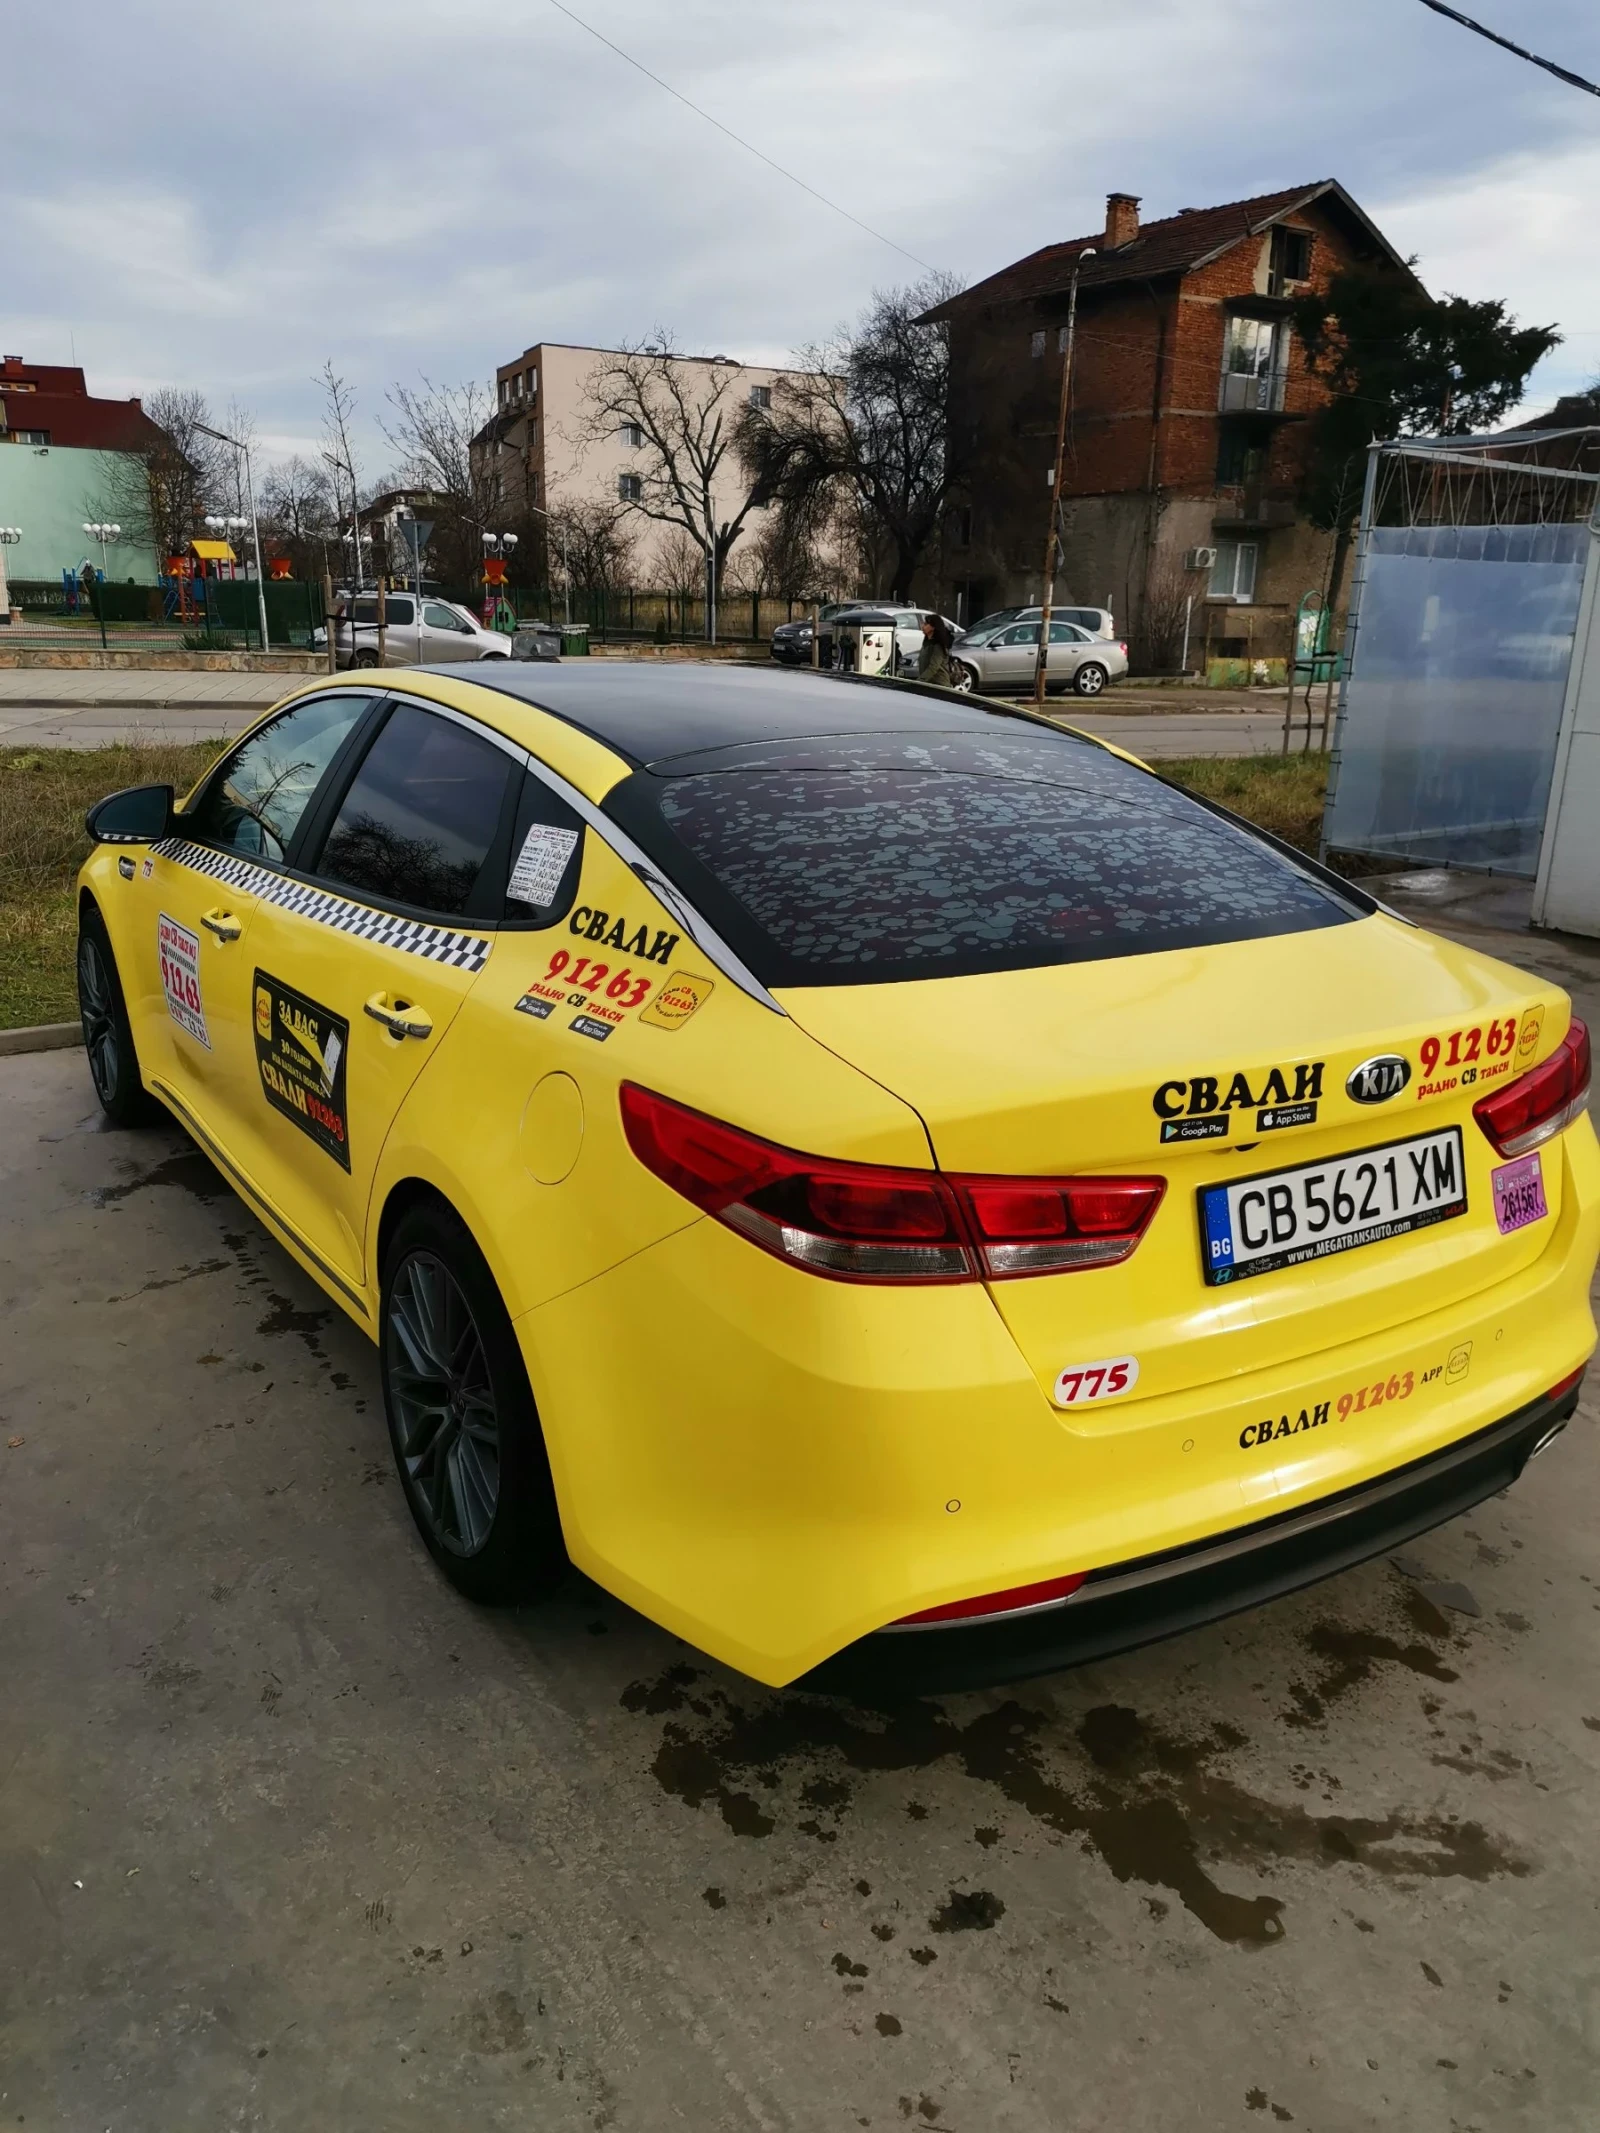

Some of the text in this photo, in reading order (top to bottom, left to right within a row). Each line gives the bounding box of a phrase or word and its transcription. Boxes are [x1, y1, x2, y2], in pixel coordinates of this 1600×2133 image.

[569, 907, 680, 965] СВАЛИ
[162, 955, 200, 1014] 91263
[543, 948, 652, 1008] 91263
[279, 1000, 292, 1026] ЗА
[294, 1009, 318, 1041] ВАС!
[567, 993, 587, 1007] СВ
[663, 994, 693, 1010] 91263
[1419, 1018, 1516, 1078] 91263
[1153, 1062, 1325, 1119] СВАЛИ
[1361, 1064, 1405, 1097] KIA
[1461, 1067, 1477, 1085] СВ
[262, 1059, 308, 1115] СВАЛИ
[306, 1094, 344, 1141] 91263
[1276, 1112, 1311, 1125] App Store
[1181, 1124, 1224, 1137] Google Play
[1502, 1181, 1540, 1222] 261567
[1211, 1238, 1231, 1258] BG
[1287, 1220, 1411, 1264] www.MEGATRANSAUTO.com
[1061, 1363, 1129, 1401] 775
[1239, 1401, 1331, 1449] СВАЛИ
[1336, 1370, 1415, 1423] 91263
